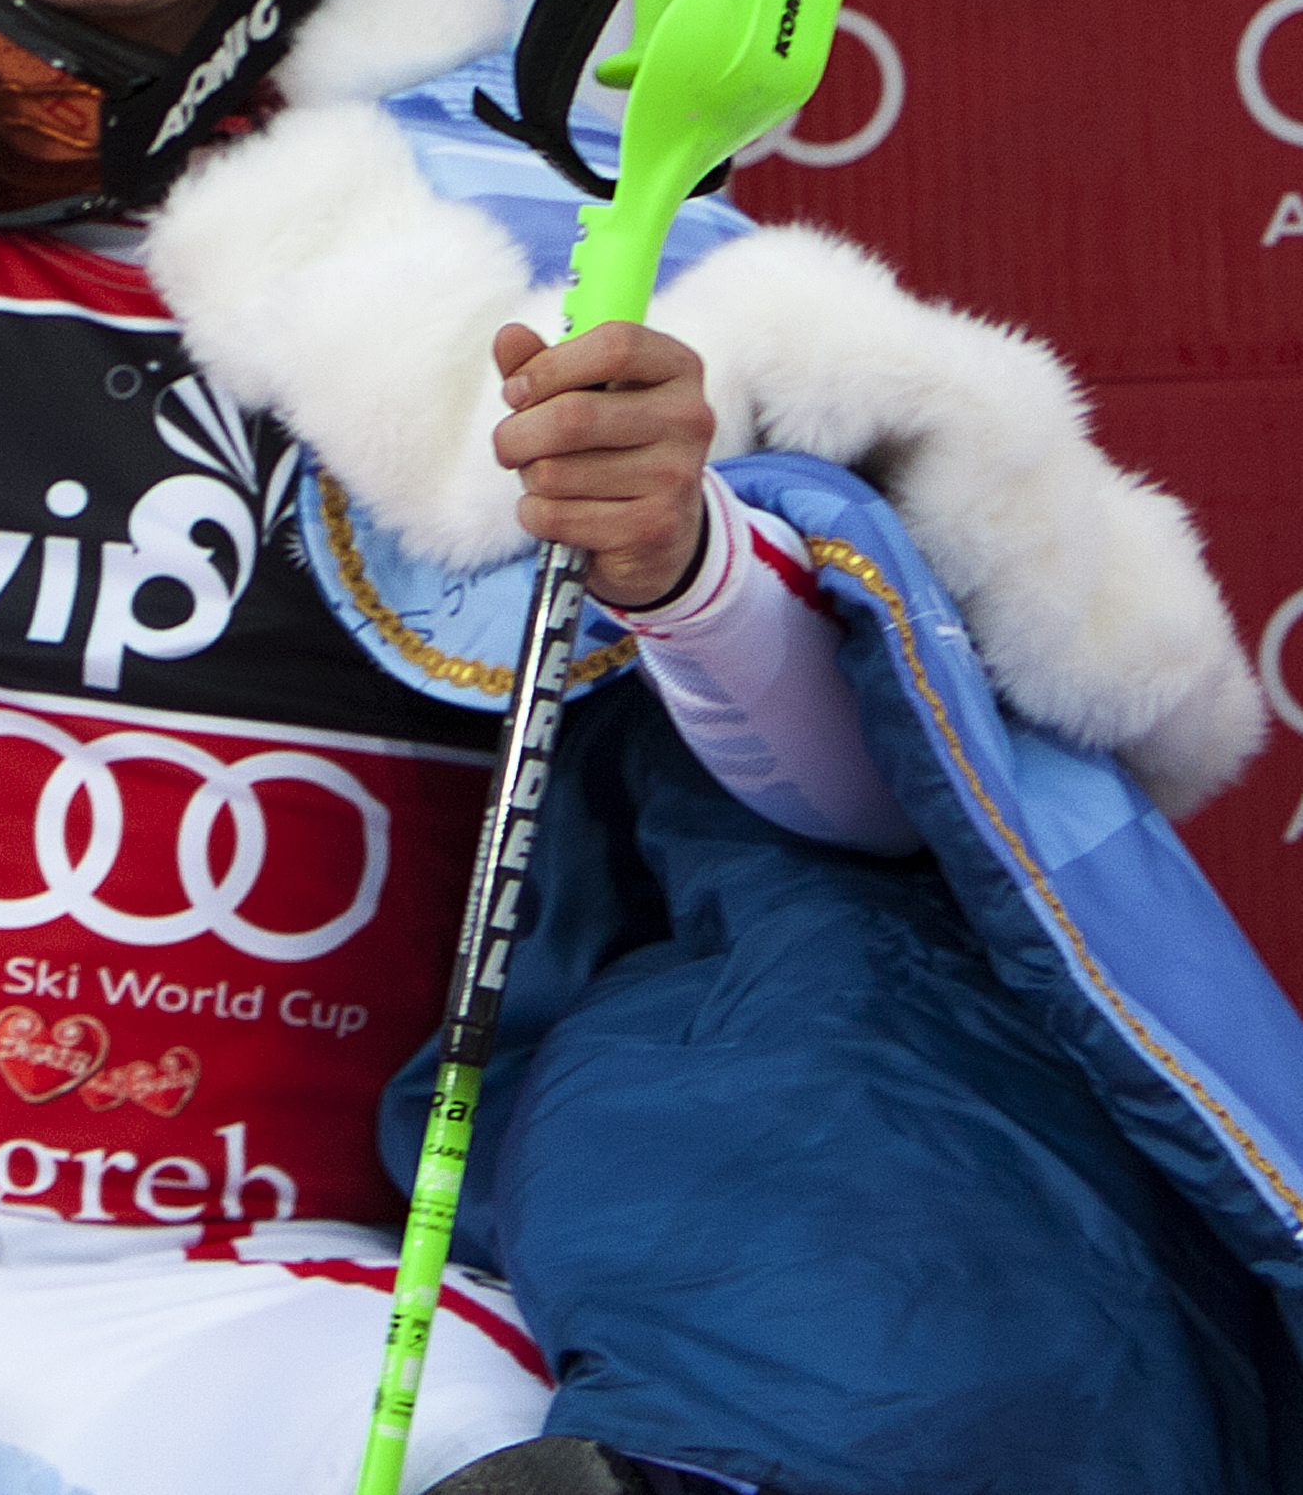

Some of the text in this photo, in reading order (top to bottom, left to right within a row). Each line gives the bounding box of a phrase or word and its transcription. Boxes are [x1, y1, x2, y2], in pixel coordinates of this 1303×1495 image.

[2, 957, 81, 1000] Ski
[98, 966, 265, 1021] World
[279, 989, 369, 1038] Cup
